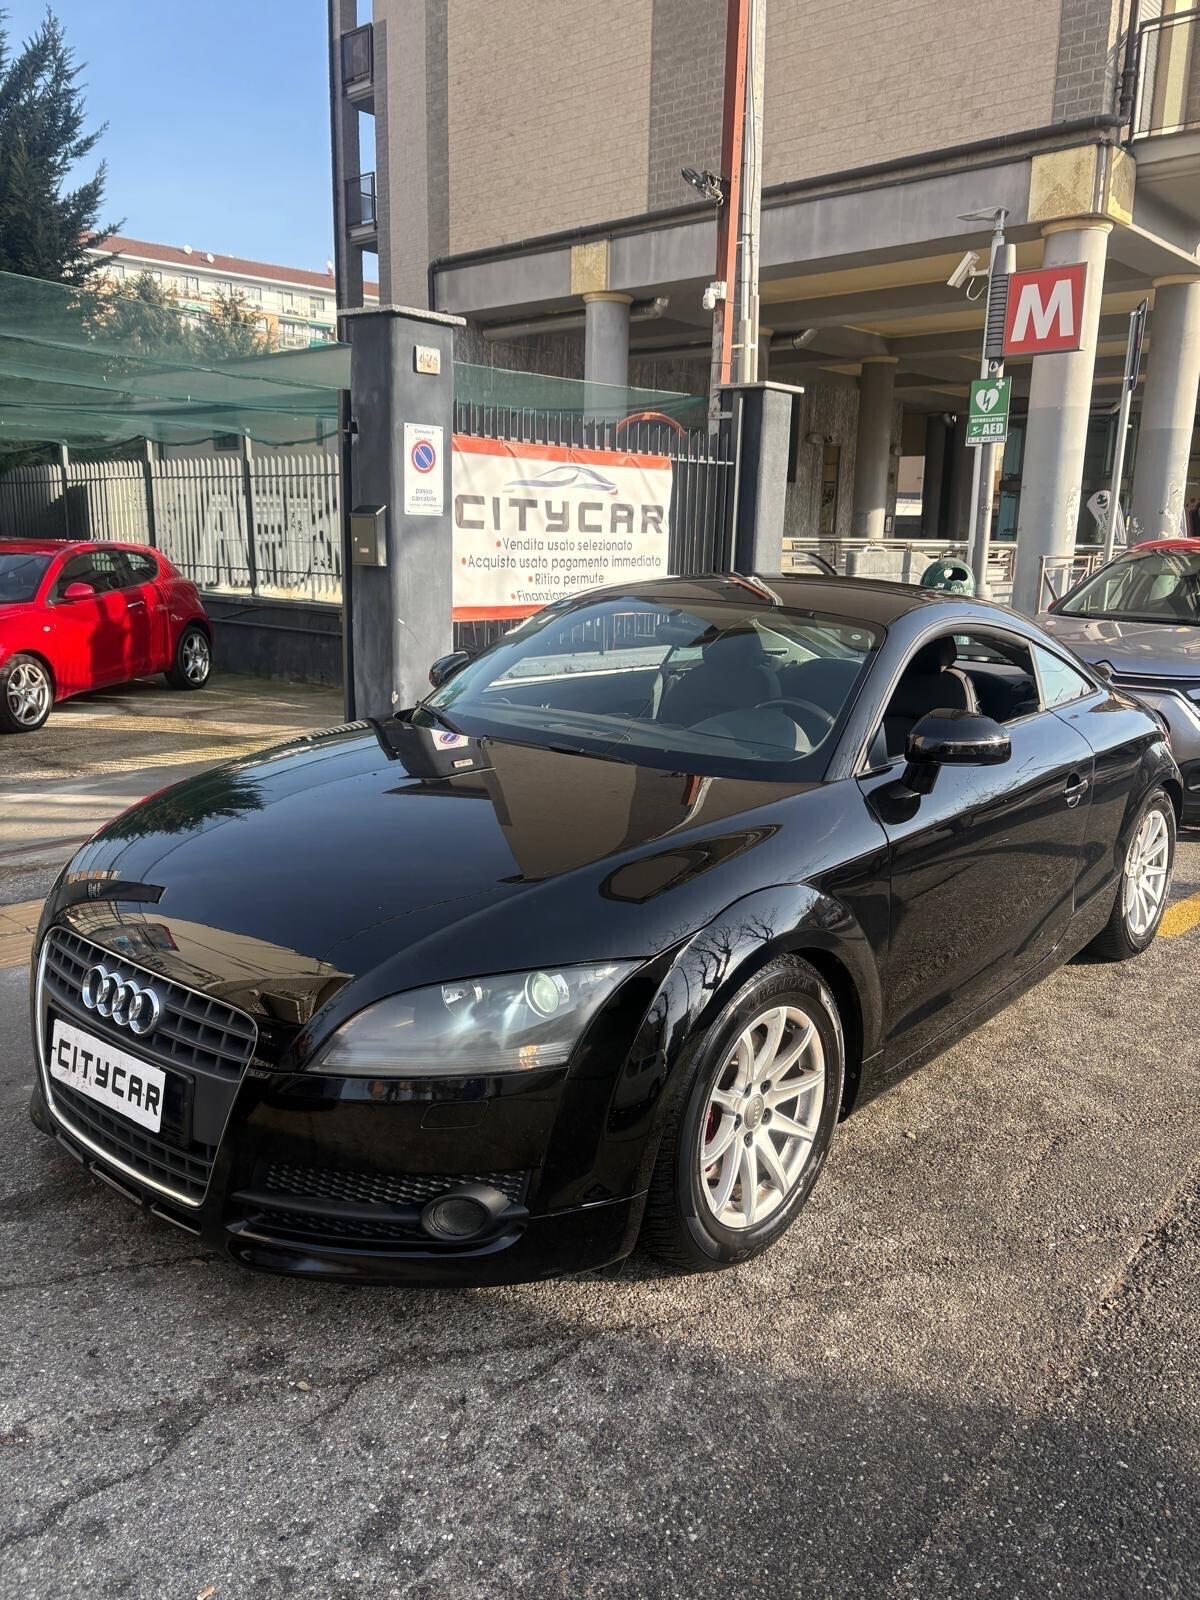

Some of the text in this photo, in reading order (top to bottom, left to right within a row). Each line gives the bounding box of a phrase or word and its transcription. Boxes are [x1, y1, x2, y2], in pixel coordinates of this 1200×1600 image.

[1011, 279, 1074, 342] M
[982, 422, 1004, 435] AED
[415, 488, 433, 496] passo
[455, 494, 664, 534] CITYCAR
[502, 537, 632, 551] Vendita usato selezionato
[468, 555, 661, 571] Acquisto usato pagamento immediato
[534, 572, 605, 586] Ritiro permute
[57, 1038, 161, 1116] CITYCAR
